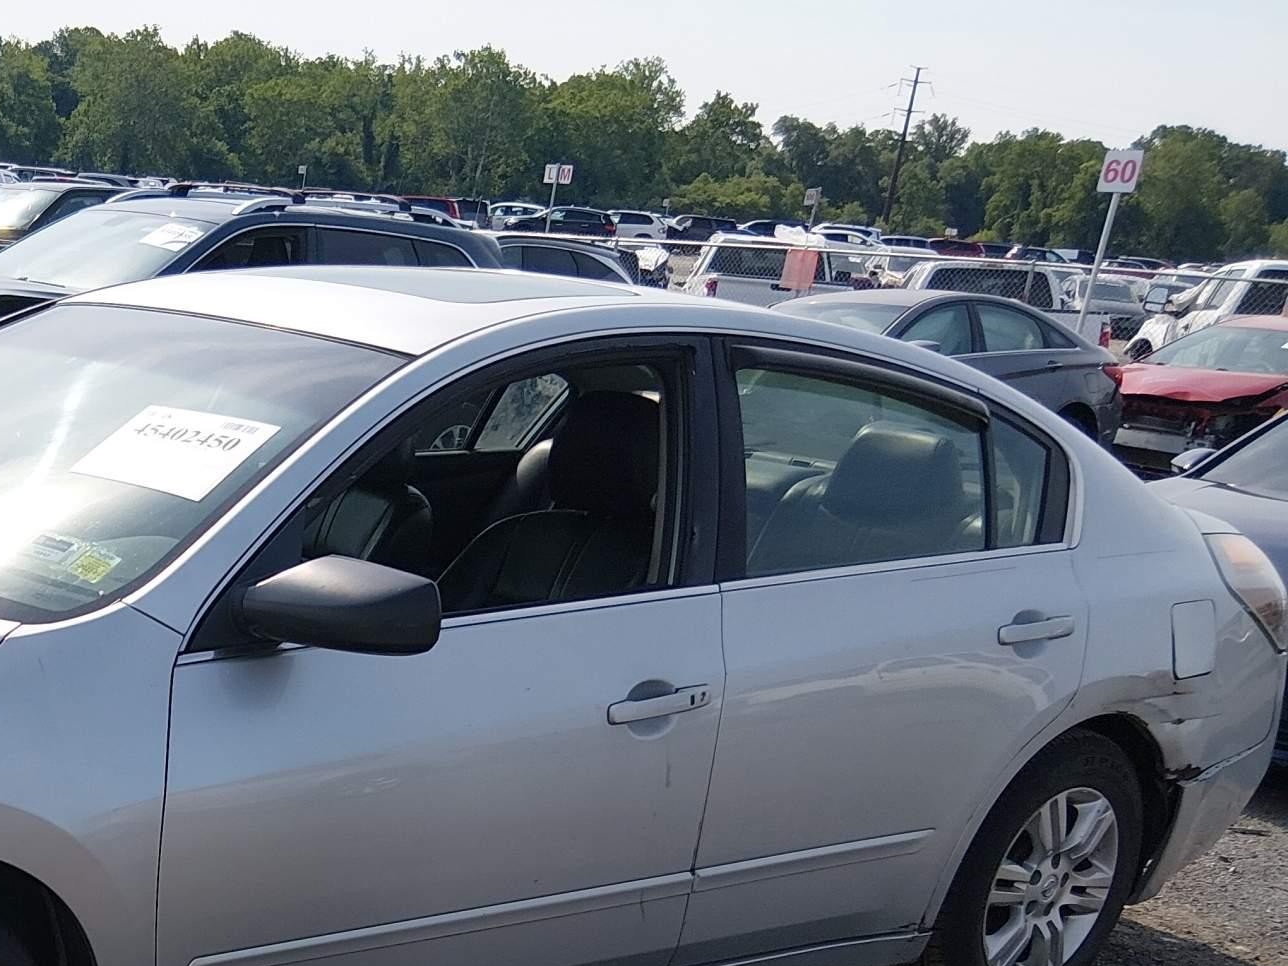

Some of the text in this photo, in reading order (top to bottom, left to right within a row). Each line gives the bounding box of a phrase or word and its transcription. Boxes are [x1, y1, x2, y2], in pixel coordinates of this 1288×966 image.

[560, 167, 571, 181] M
[1103, 159, 1137, 184] 60
[134, 423, 241, 451] 45402450
